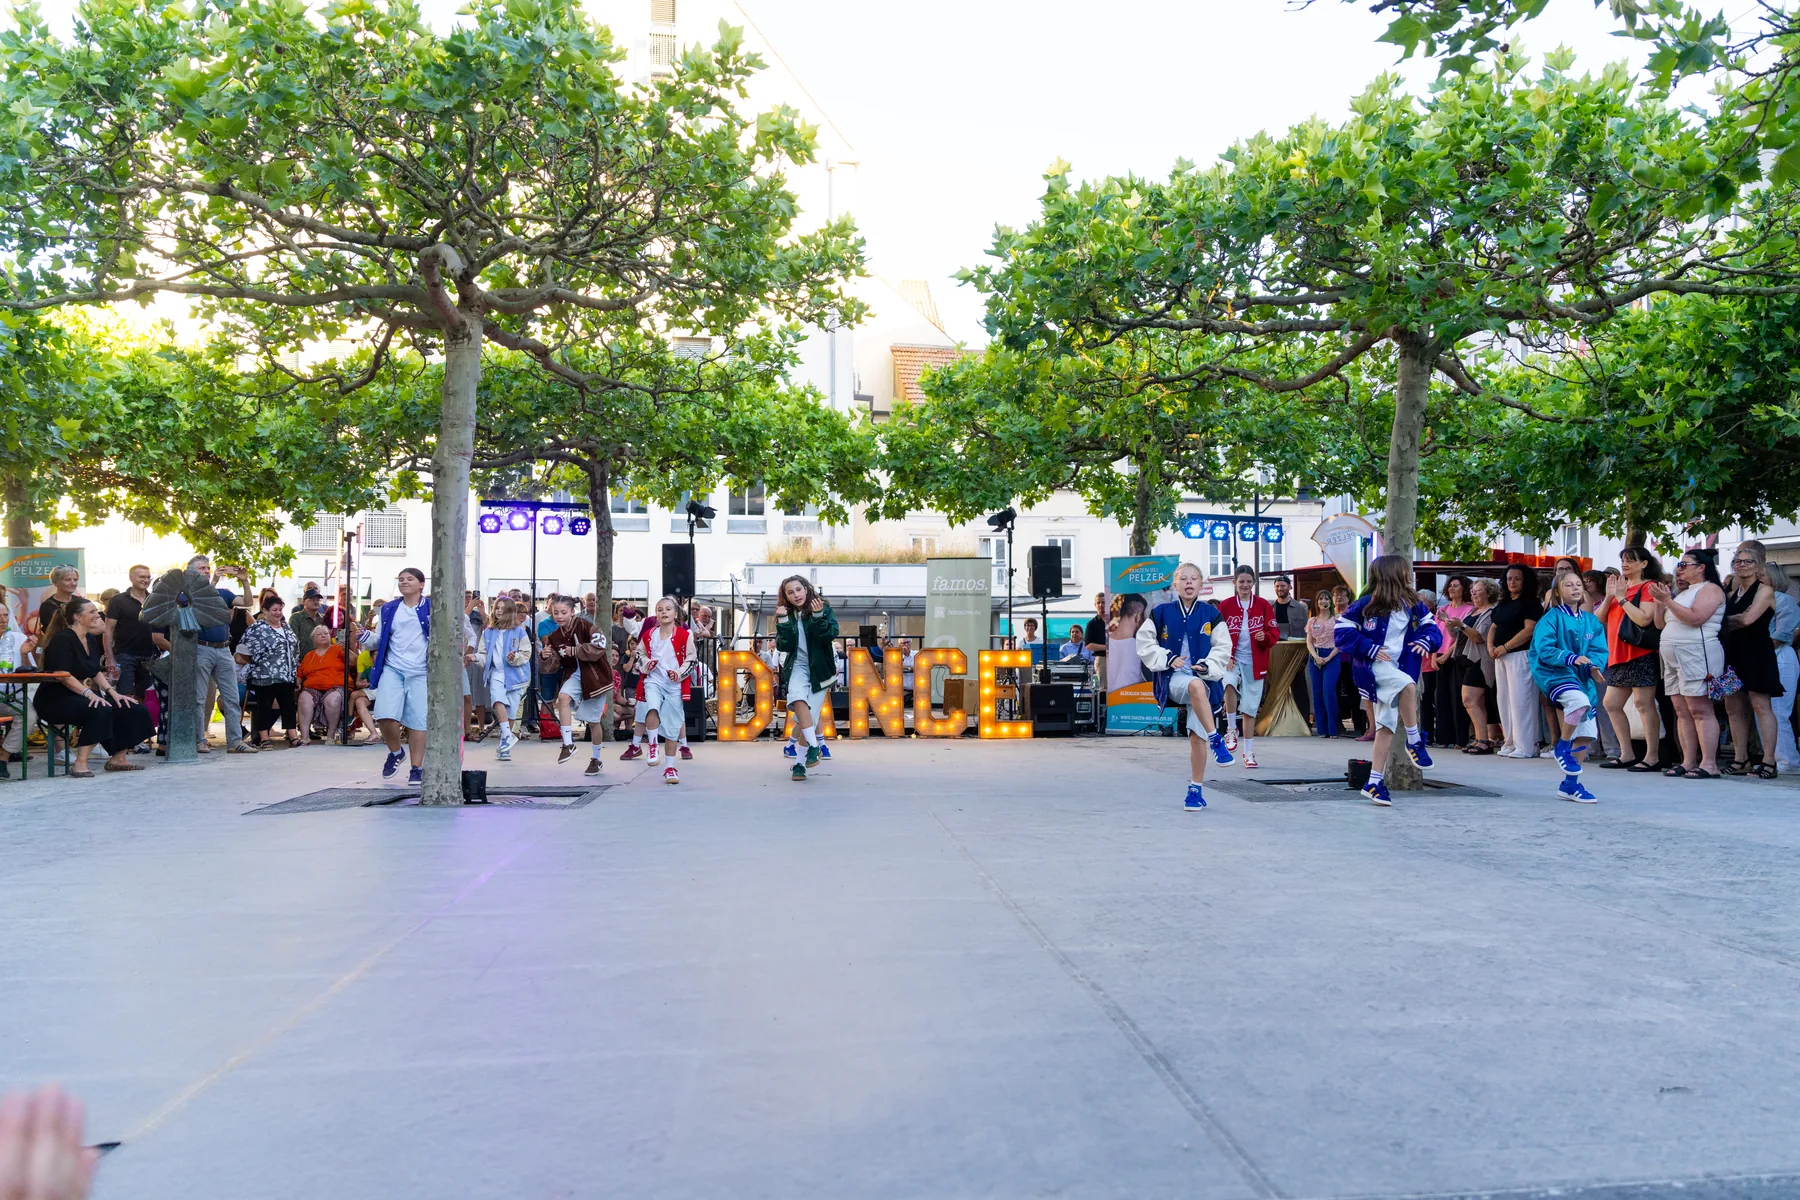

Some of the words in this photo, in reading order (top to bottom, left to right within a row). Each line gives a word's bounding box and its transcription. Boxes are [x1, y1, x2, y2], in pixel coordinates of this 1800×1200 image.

[13, 566, 53, 575] PELZE
[931, 576, 988, 591] famos.
[1129, 573, 1170, 583] PELZER
[591, 632, 607, 649] 23
